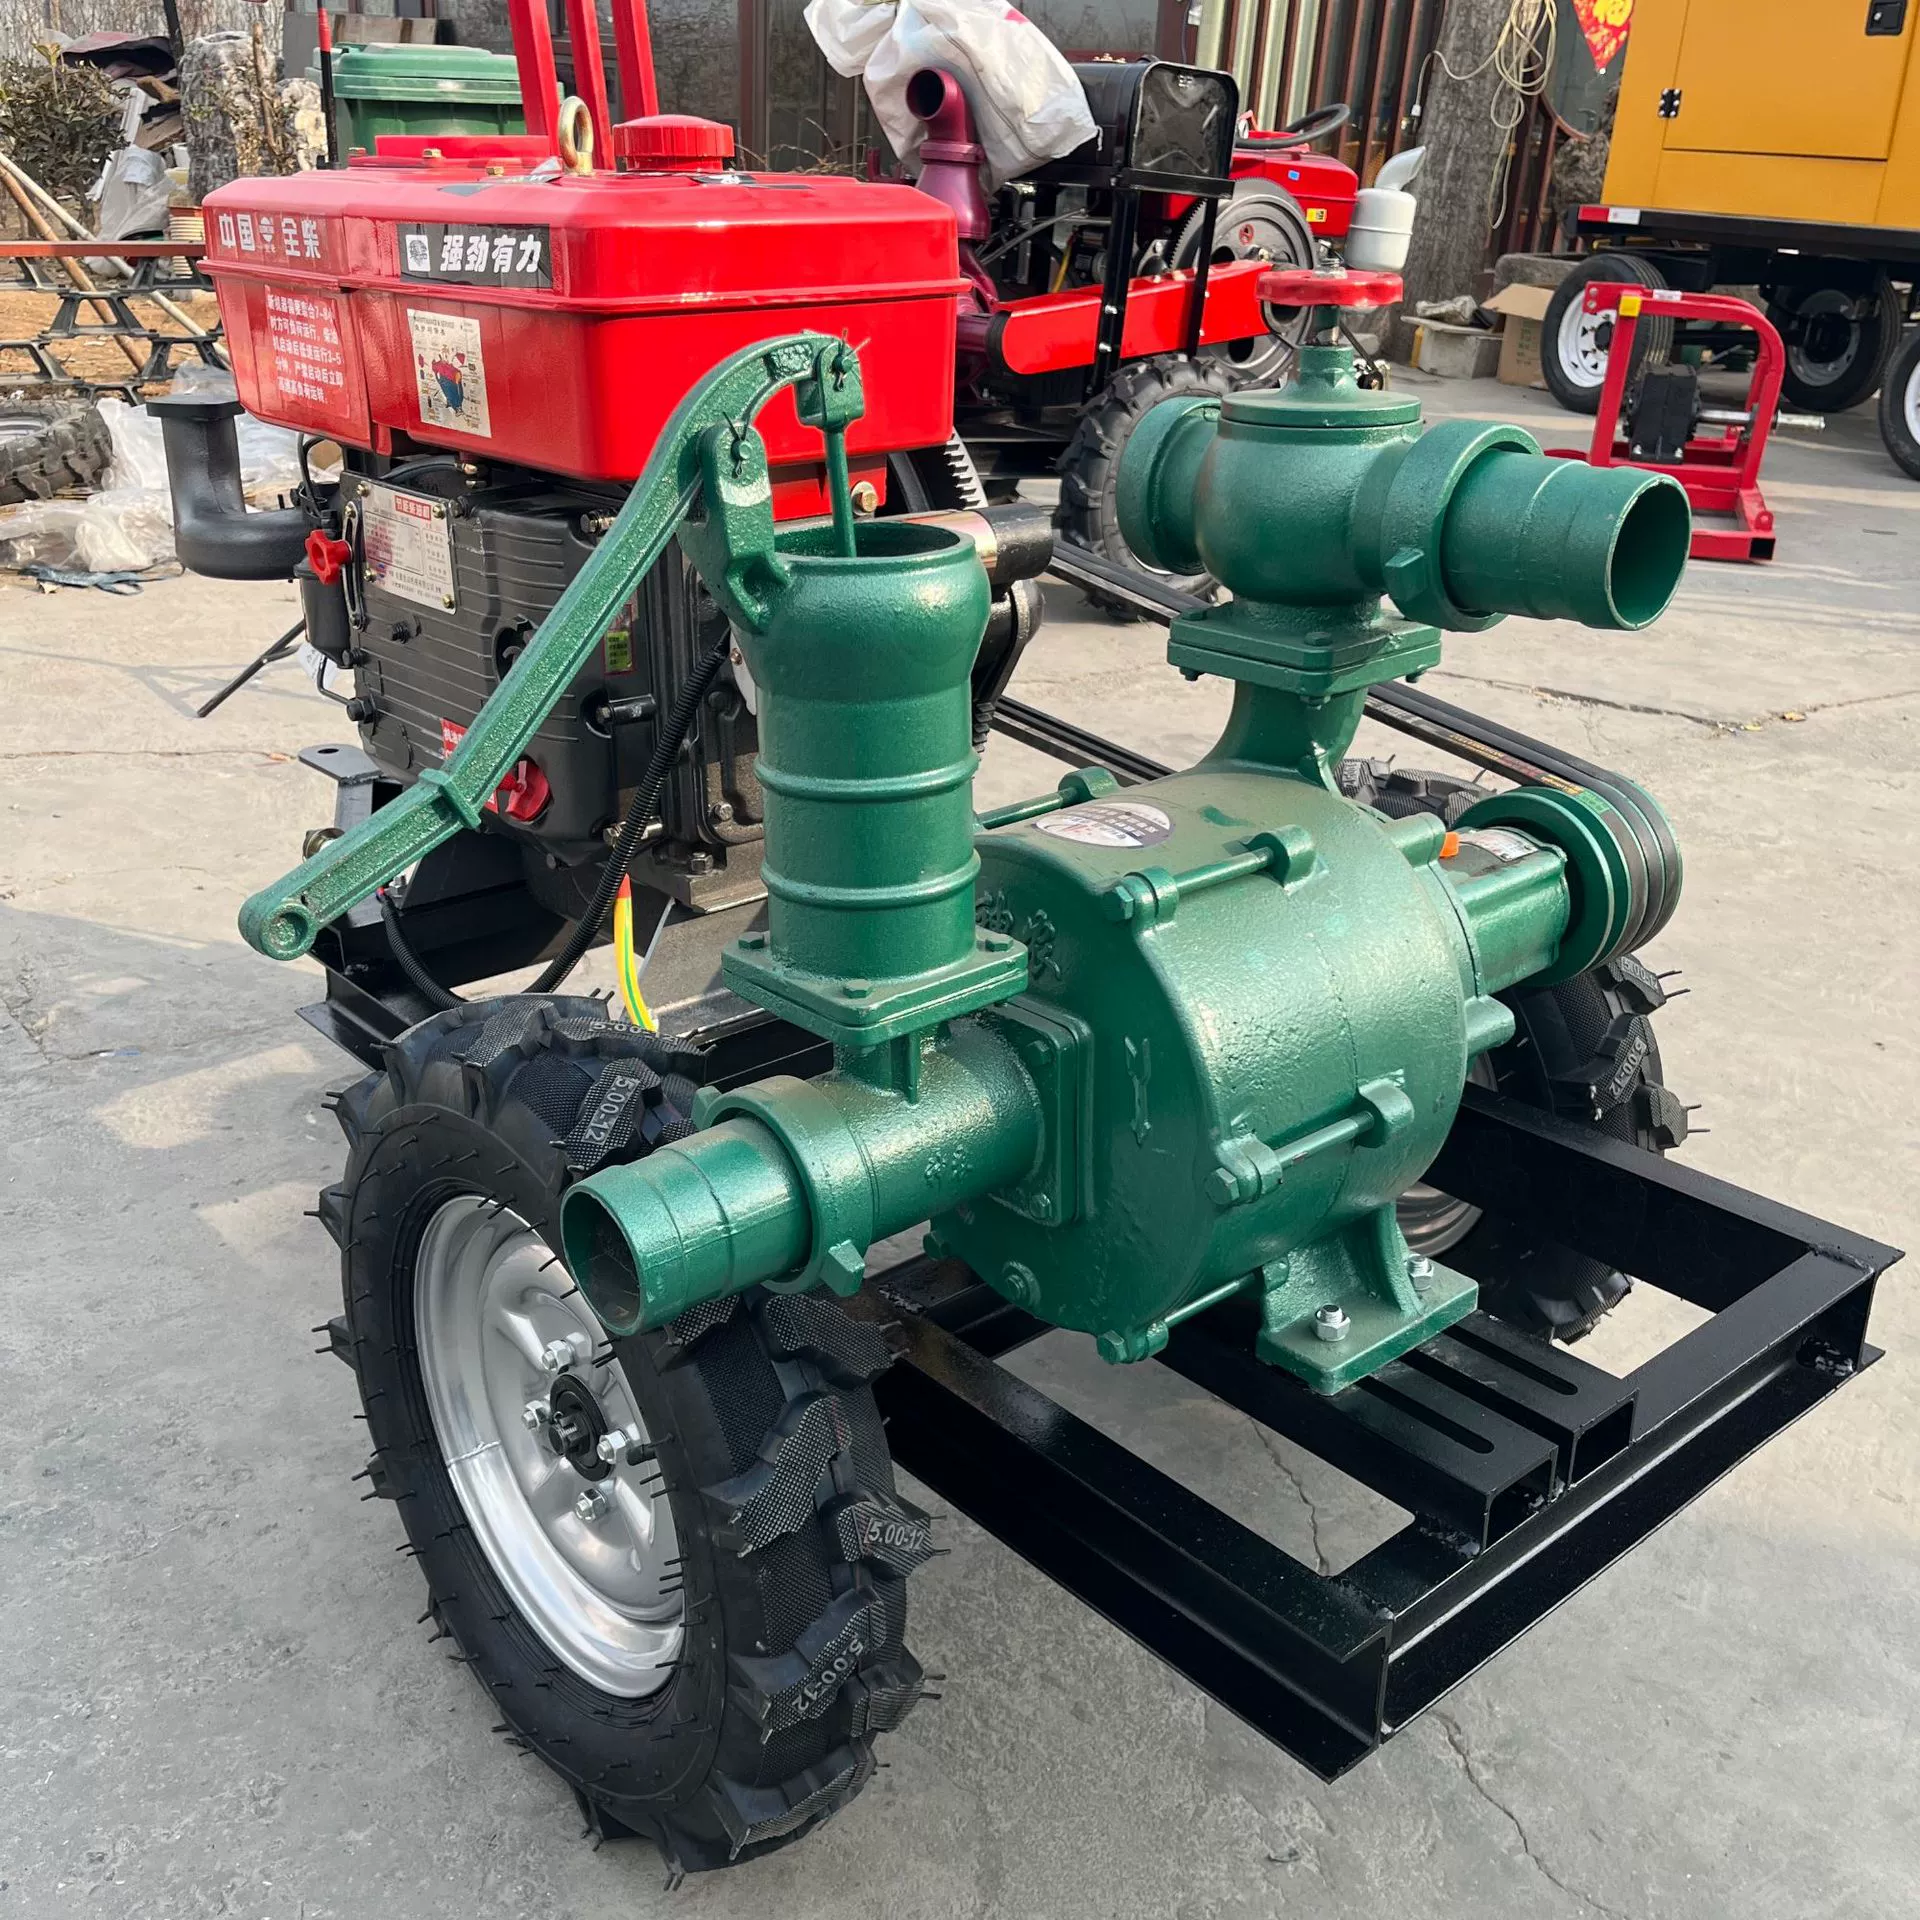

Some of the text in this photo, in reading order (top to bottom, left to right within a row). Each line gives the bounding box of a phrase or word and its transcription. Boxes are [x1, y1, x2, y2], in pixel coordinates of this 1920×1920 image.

[218, 213, 321, 259] 中国 全柴
[439, 234, 542, 273] 强劲有力
[1609, 1036, 1648, 1097] 5.00-12
[585, 1077, 636, 1142] 5.00-12
[867, 1520, 925, 1550] 5.00-12
[791, 1634, 864, 1711] 5.00-12
